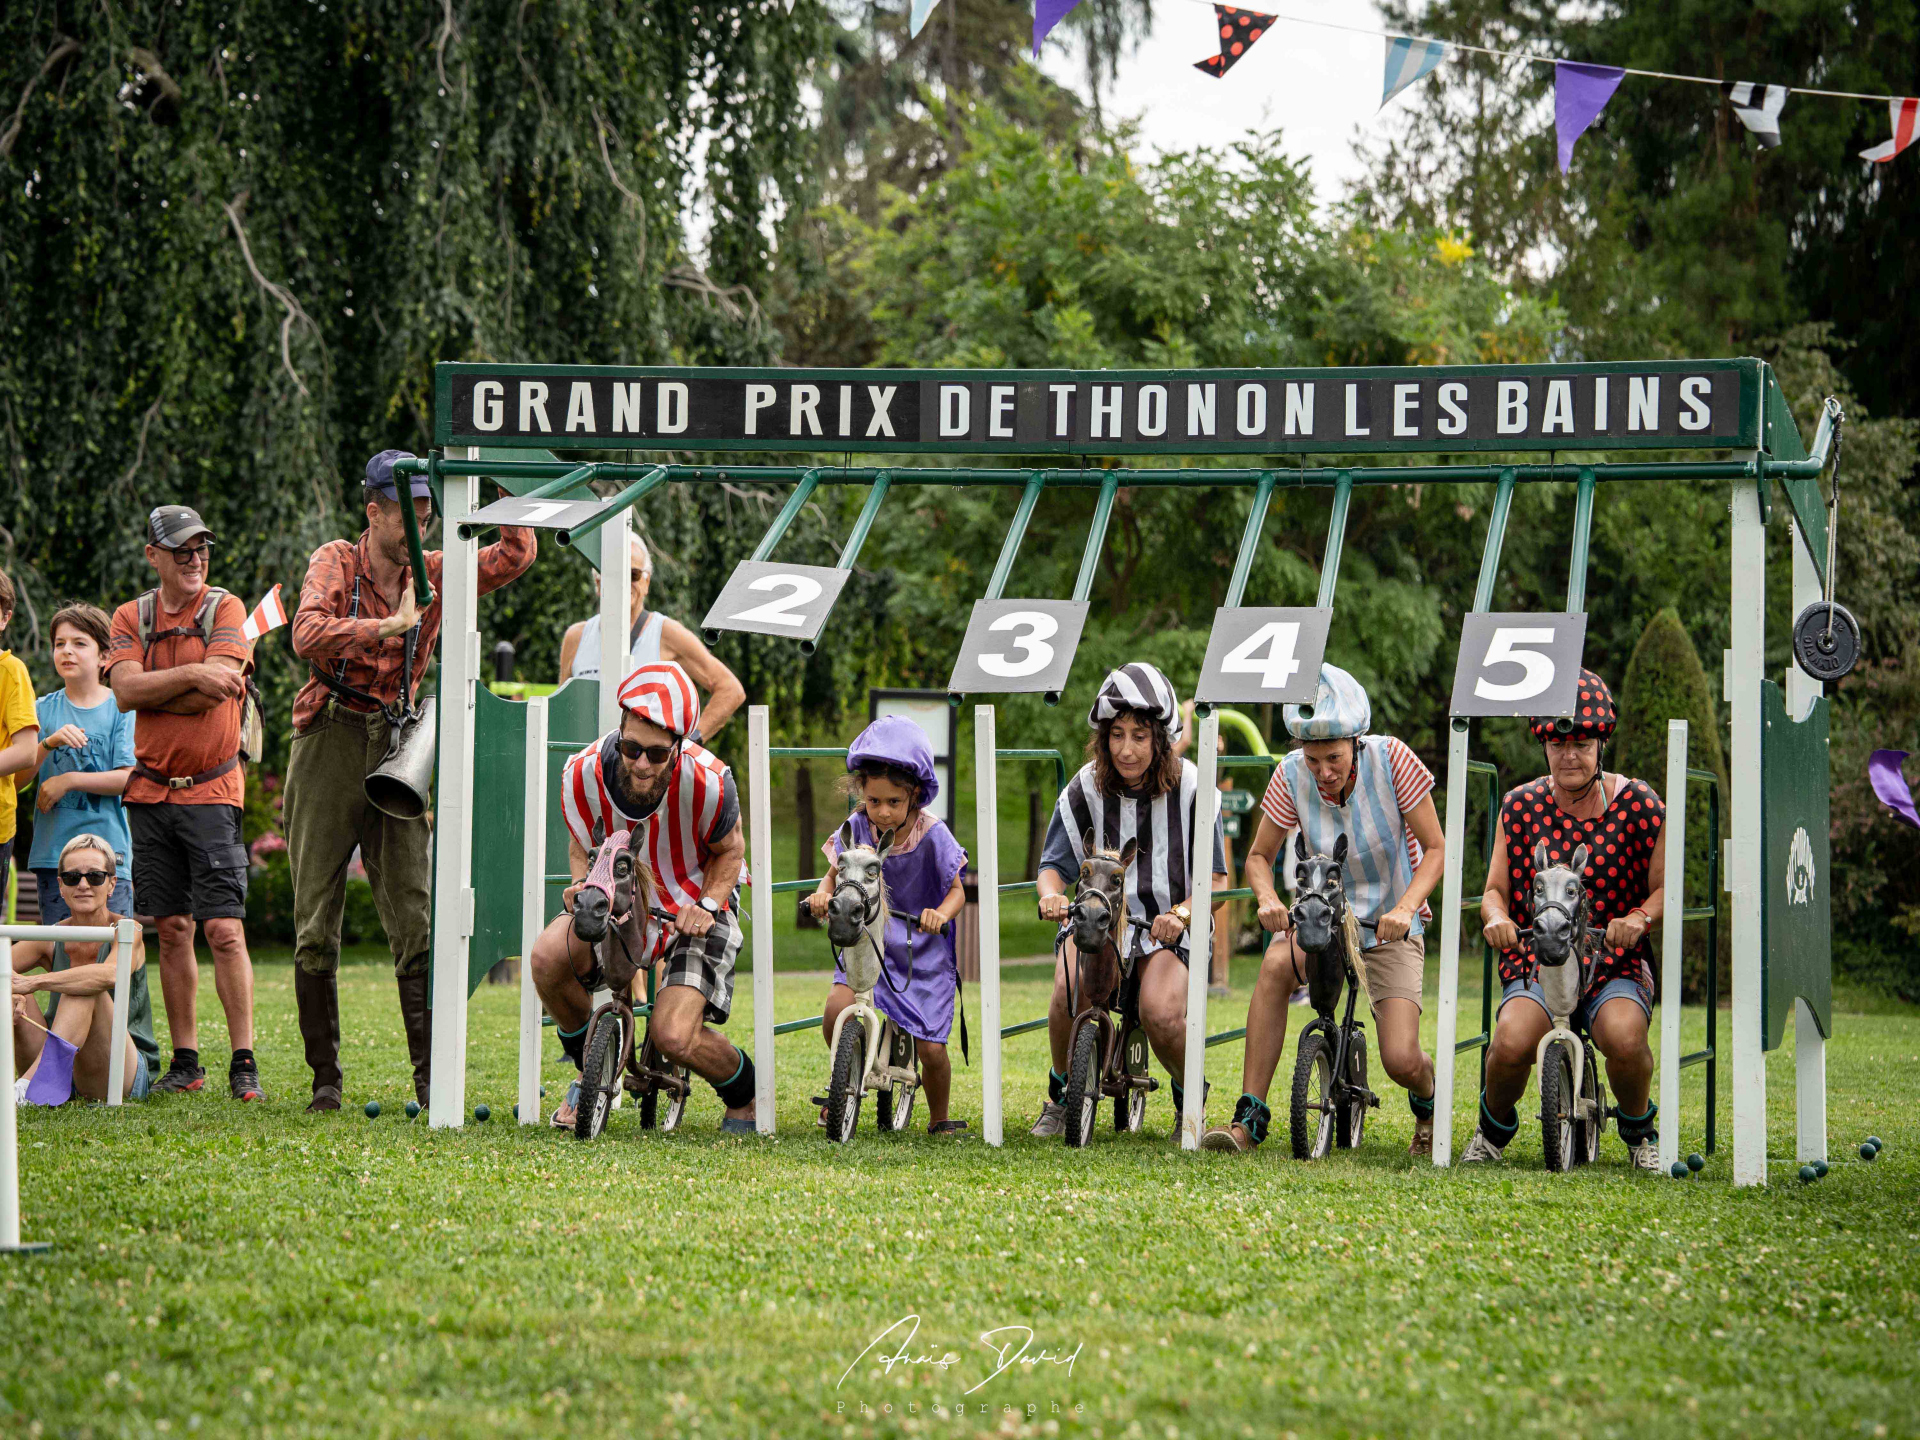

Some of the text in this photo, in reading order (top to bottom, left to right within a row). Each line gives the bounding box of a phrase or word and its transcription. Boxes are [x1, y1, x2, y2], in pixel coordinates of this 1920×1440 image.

[472, 376, 1711, 439] GRAND PRIX DE THONON LES BAINS
[517, 502, 573, 522] 1
[727, 573, 823, 627] 2
[977, 611, 1059, 677] 3
[1220, 622, 1301, 689] 4
[1474, 627, 1555, 701] 5
[898, 1034, 906, 1056] 5
[1130, 1042, 1142, 1064] 10
[1354, 1050, 1360, 1072] 1
